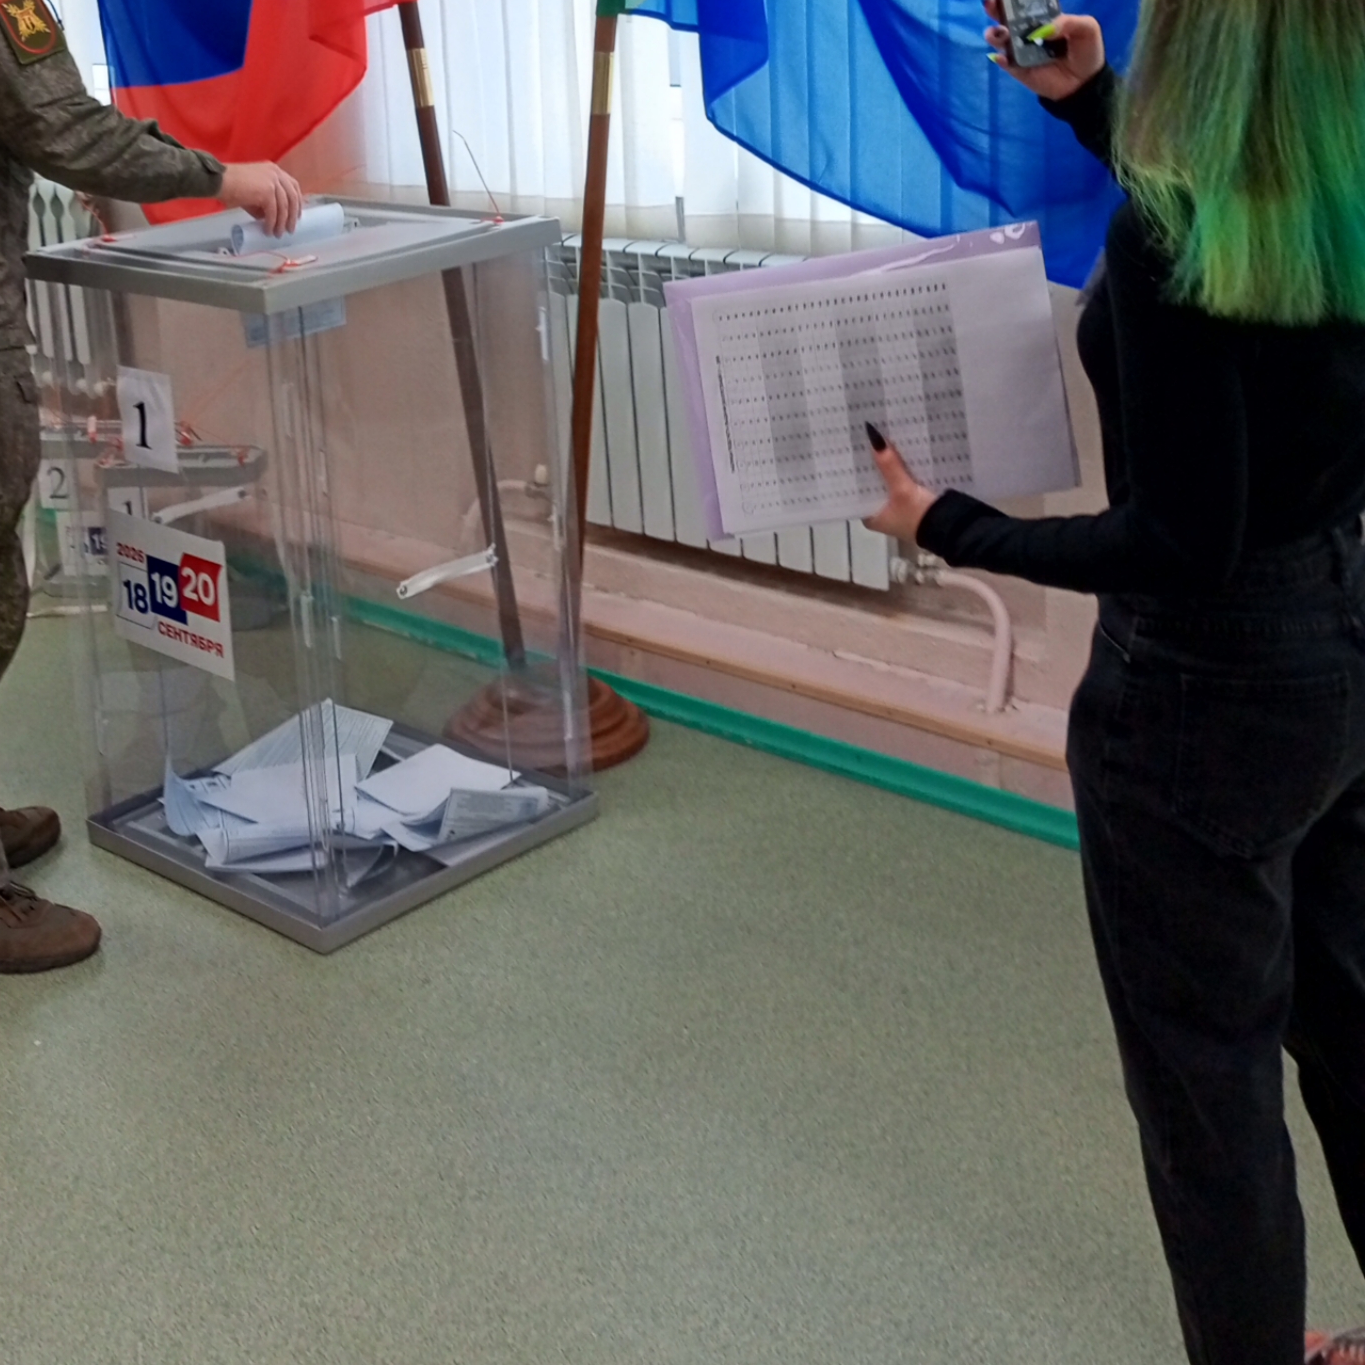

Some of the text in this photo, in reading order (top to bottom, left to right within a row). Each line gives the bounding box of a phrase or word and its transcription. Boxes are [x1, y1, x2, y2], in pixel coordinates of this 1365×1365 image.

[133, 401, 152, 450] 1
[47, 467, 70, 499] 2
[123, 567, 216, 614] 18 19 20
[157, 621, 225, 658] СЕНТЯБРЯ
